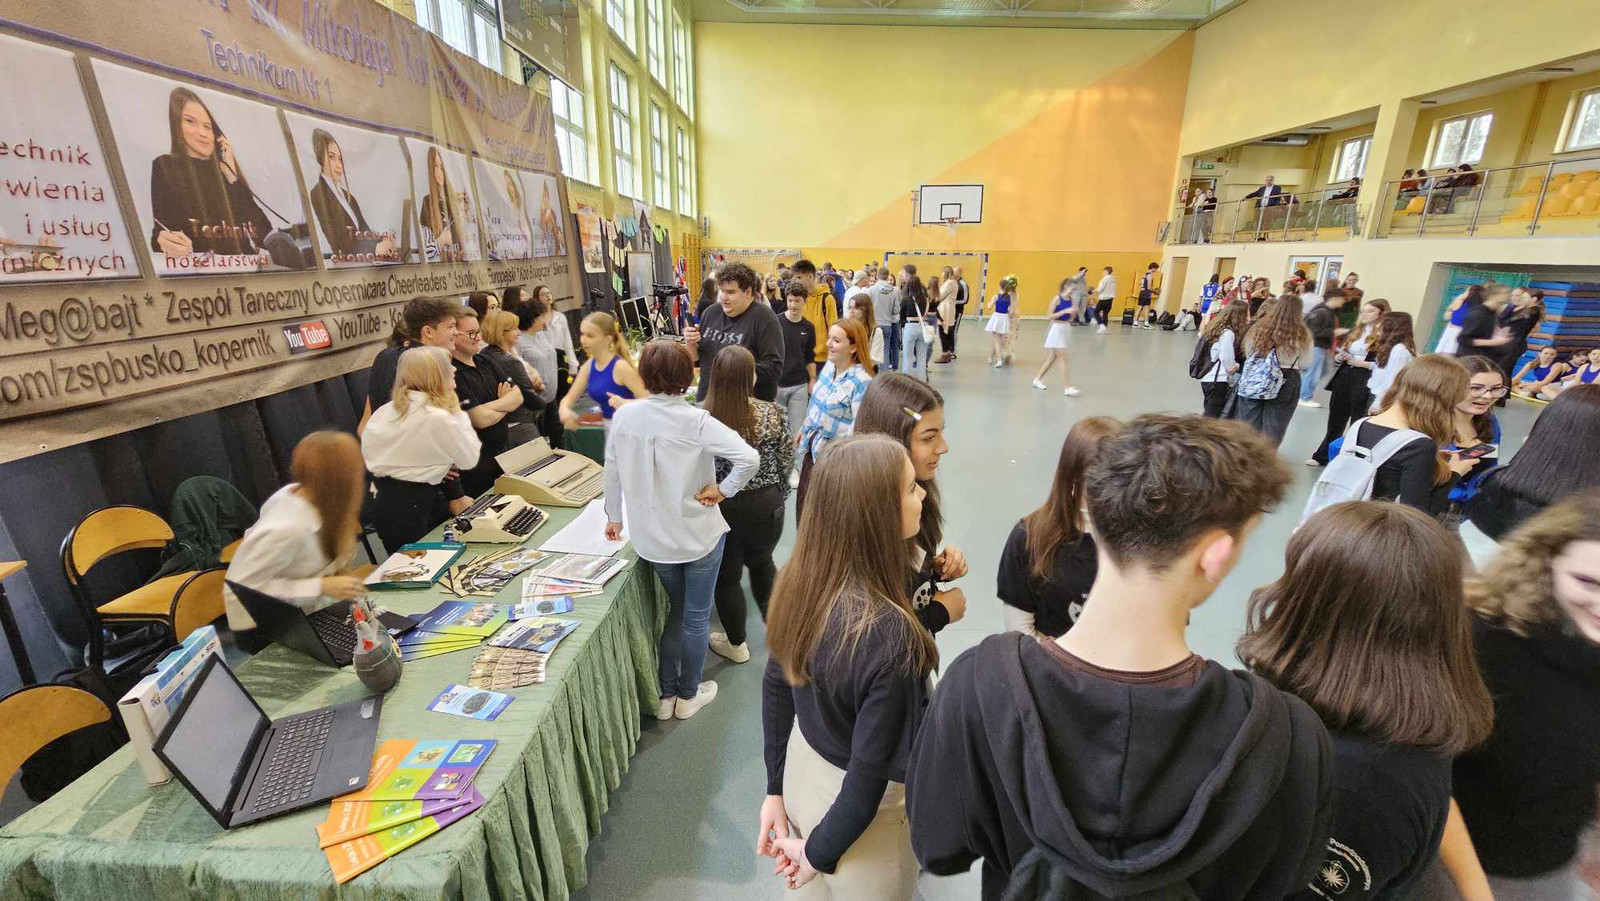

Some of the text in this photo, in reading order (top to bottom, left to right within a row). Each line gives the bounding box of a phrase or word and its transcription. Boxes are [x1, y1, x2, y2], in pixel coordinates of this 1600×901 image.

[200, 27, 333, 105] Technikum Nr 1
[6, 176, 105, 202] wienia
[25, 213, 31, 235] i
[188, 218, 259, 240] Technik
[2, 250, 126, 276] micznych
[0, 294, 142, 346] Meg@bajt
[162, 287, 232, 326] Zespół
[233, 286, 310, 316] Taneczny
[312, 279, 387, 309] Copernicana
[388, 269, 449, 296] Cheerleaders
[0, 327, 276, 404] om/zspbusko_kopernik
[283, 324, 330, 349] YouTube
[333, 312, 382, 341] YouTube
